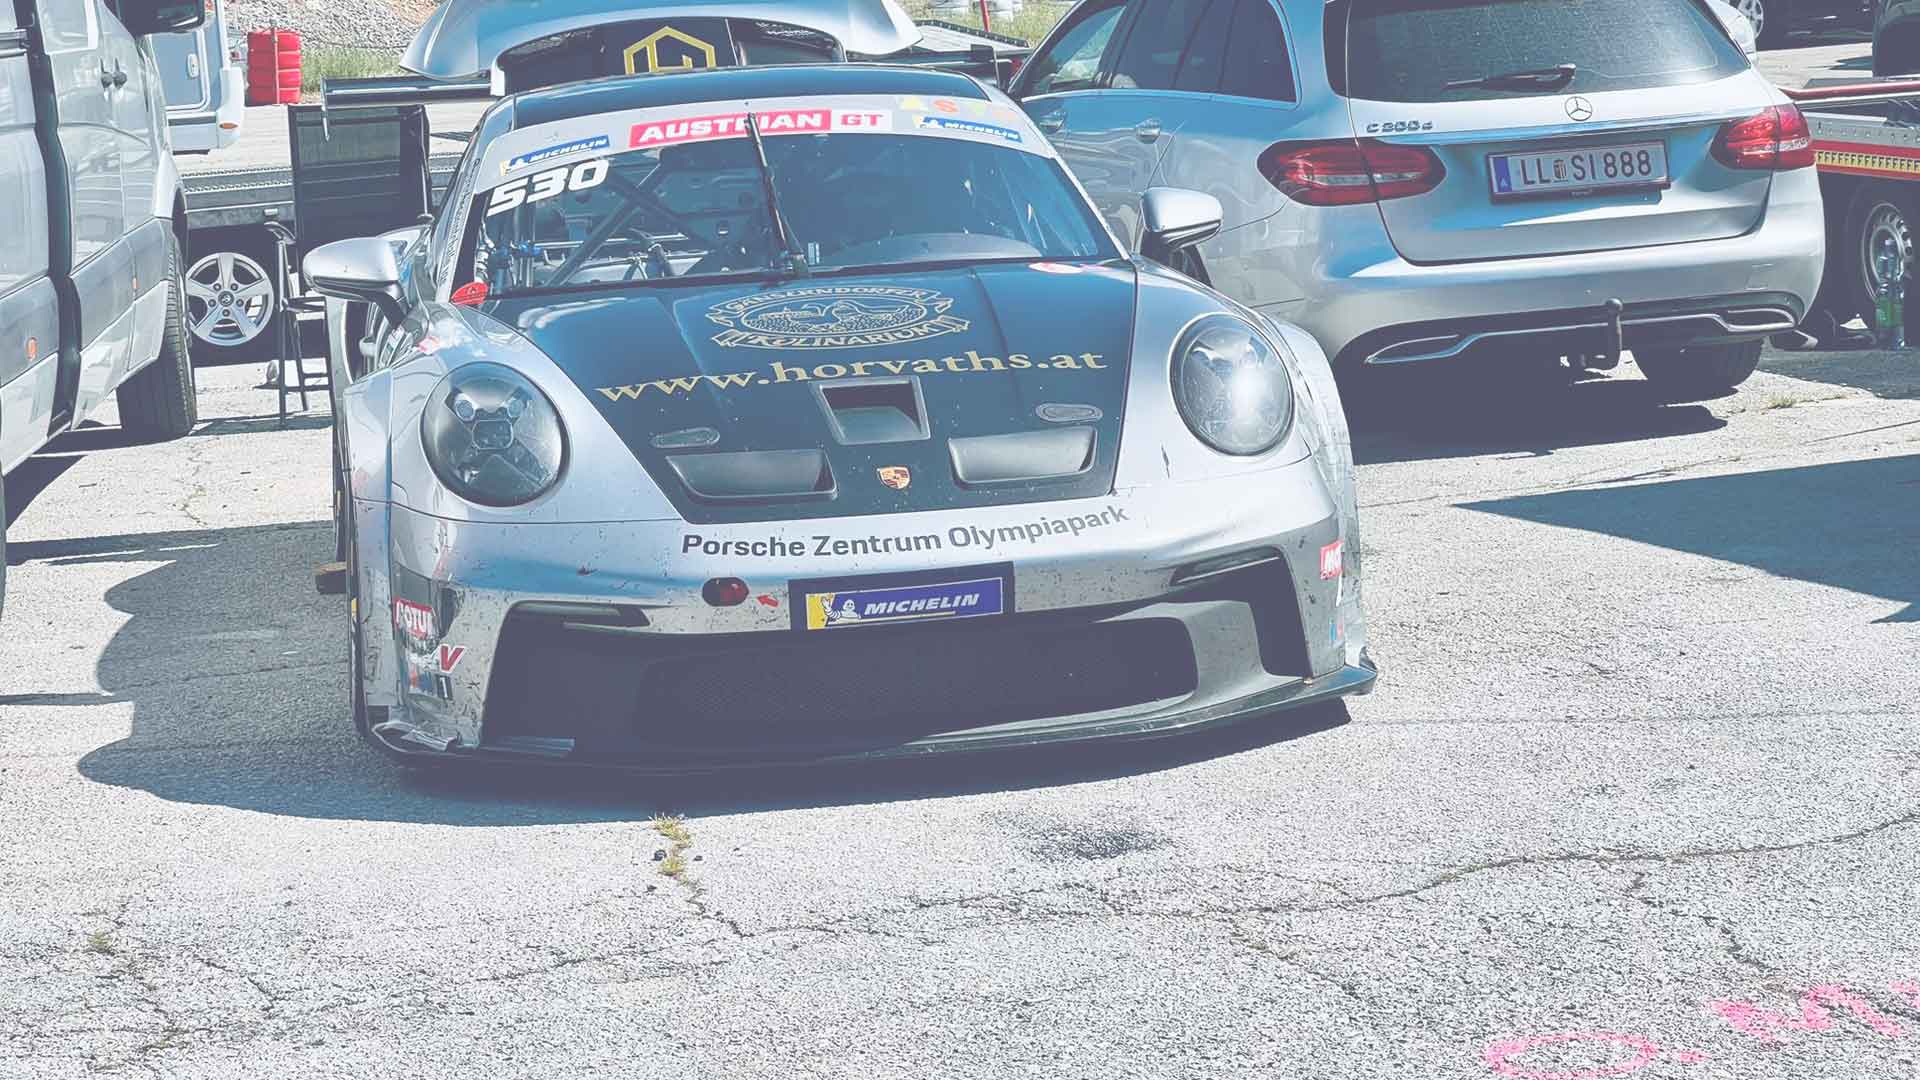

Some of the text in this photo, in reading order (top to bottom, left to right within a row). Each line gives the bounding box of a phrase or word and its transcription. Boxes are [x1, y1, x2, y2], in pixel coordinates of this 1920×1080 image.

[840, 113, 885, 127] GT
[943, 121, 1019, 139] MICHELIN
[530, 137, 608, 163] MICHELIN
[1520, 149, 1652, 186] LL SI 888
[486, 159, 610, 217] 530
[594, 350, 1108, 402] www.horvaths.at
[682, 504, 1130, 557] Porsche Zentrum Olympiapark
[863, 592, 981, 616] MICHELIN
